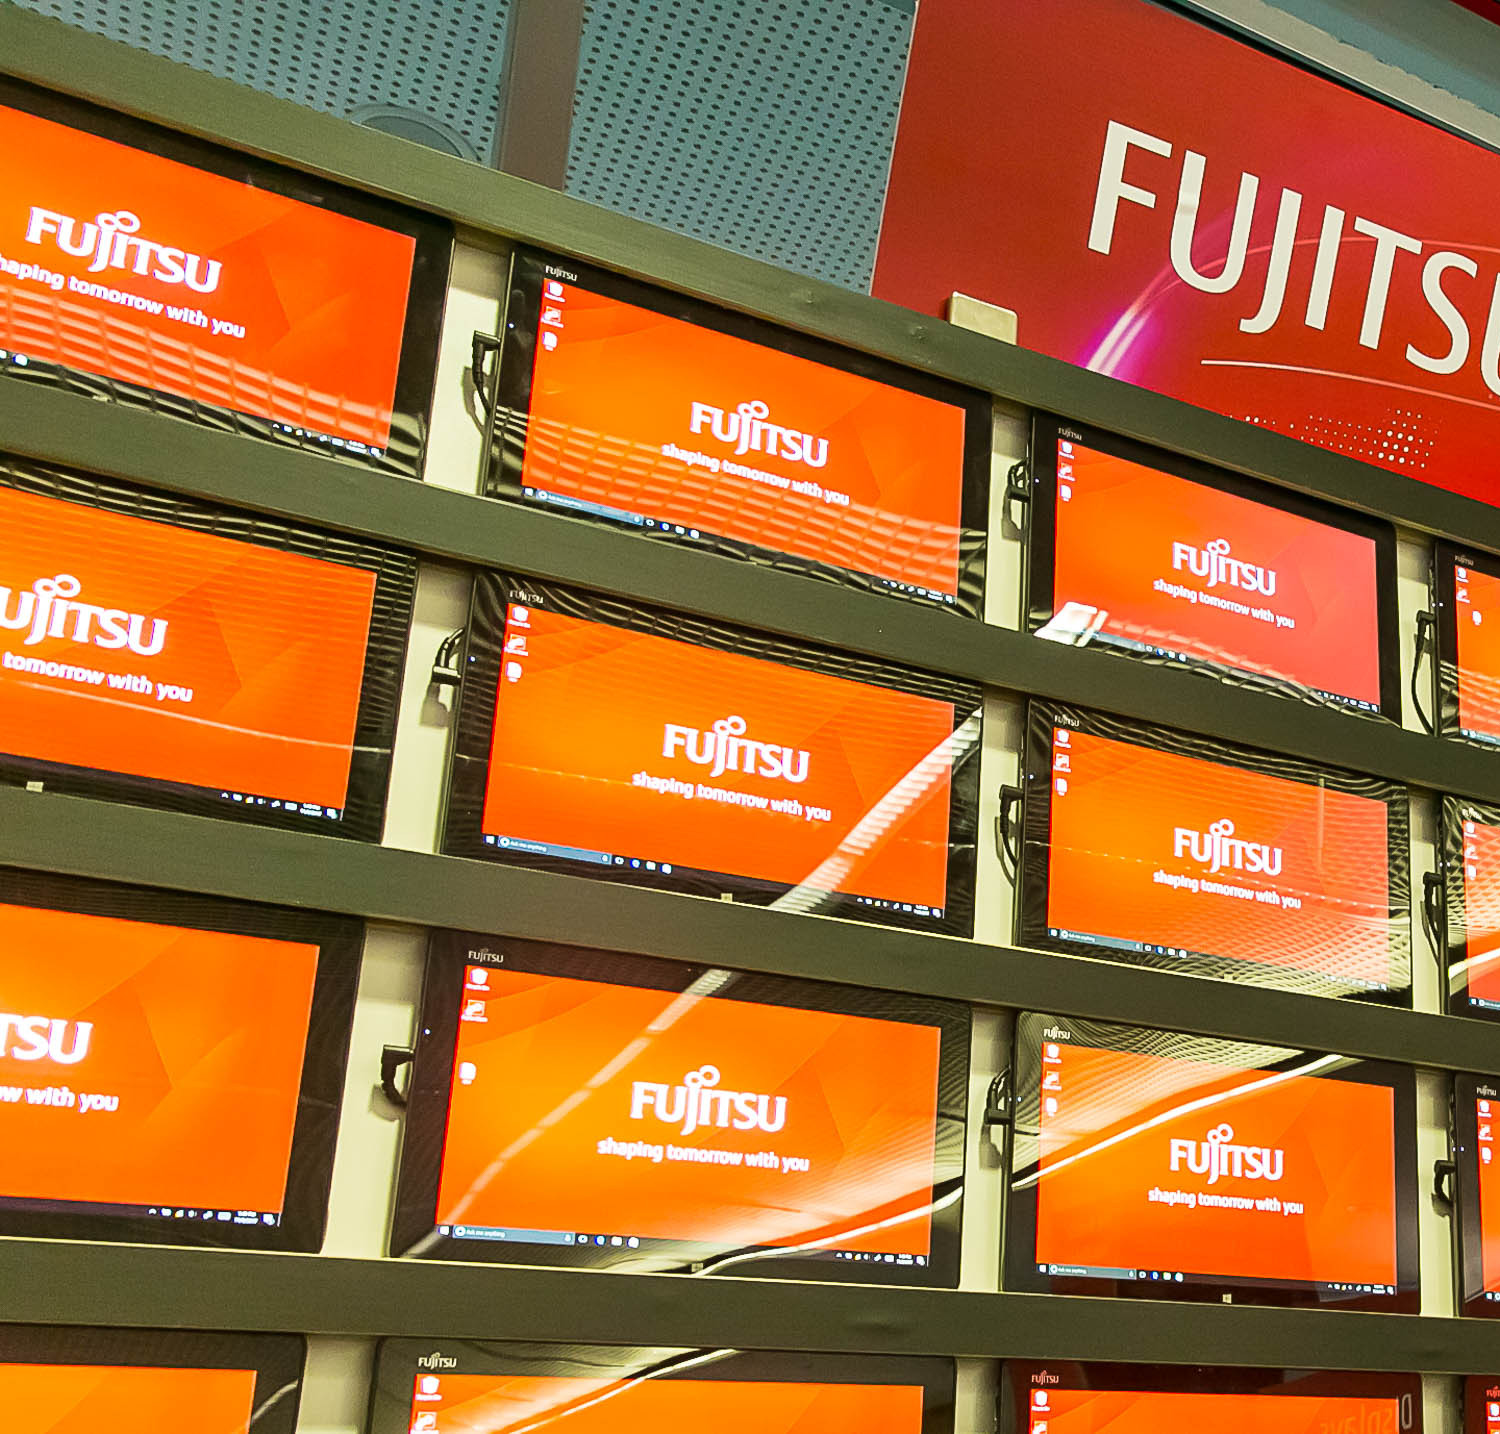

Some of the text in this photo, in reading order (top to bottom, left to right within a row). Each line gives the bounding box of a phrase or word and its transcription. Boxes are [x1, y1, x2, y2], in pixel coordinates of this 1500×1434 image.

[25, 209, 222, 293] FUJITSU
[545, 264, 577, 281] FUJITSU
[0, 255, 245, 337] haping tomorrow with you
[689, 401, 828, 468] FUJITSU
[662, 444, 849, 505] shaping tomorrow with you
[1173, 539, 1276, 597] FUJITSU
[0, 574, 168, 656] UJITSU
[1155, 579, 1294, 628] shaping tomorrow with you
[4, 652, 192, 701] tomorrow with you
[662, 716, 809, 783] FUJITSU
[633, 772, 830, 820] shaping tomorrow with you
[1174, 819, 1282, 876] FUJITSU
[1154, 871, 1301, 908] shaping tomorrow with you
[468, 948, 503, 963] FUJITSU
[1043, 1025, 1071, 1040] FUJITSU
[27, 1087, 75, 1106] with
[80, 1094, 118, 1112] you
[631, 1066, 786, 1135] FUJITSU
[598, 1138, 809, 1172] shaping tomorrow with you
[1171, 1124, 1283, 1184] FUJITSU
[1149, 1188, 1303, 1215] shaping tomorrow with you
[418, 1352, 457, 1369] FUJITSU
[1031, 1370, 1059, 1385] FUJITSU
